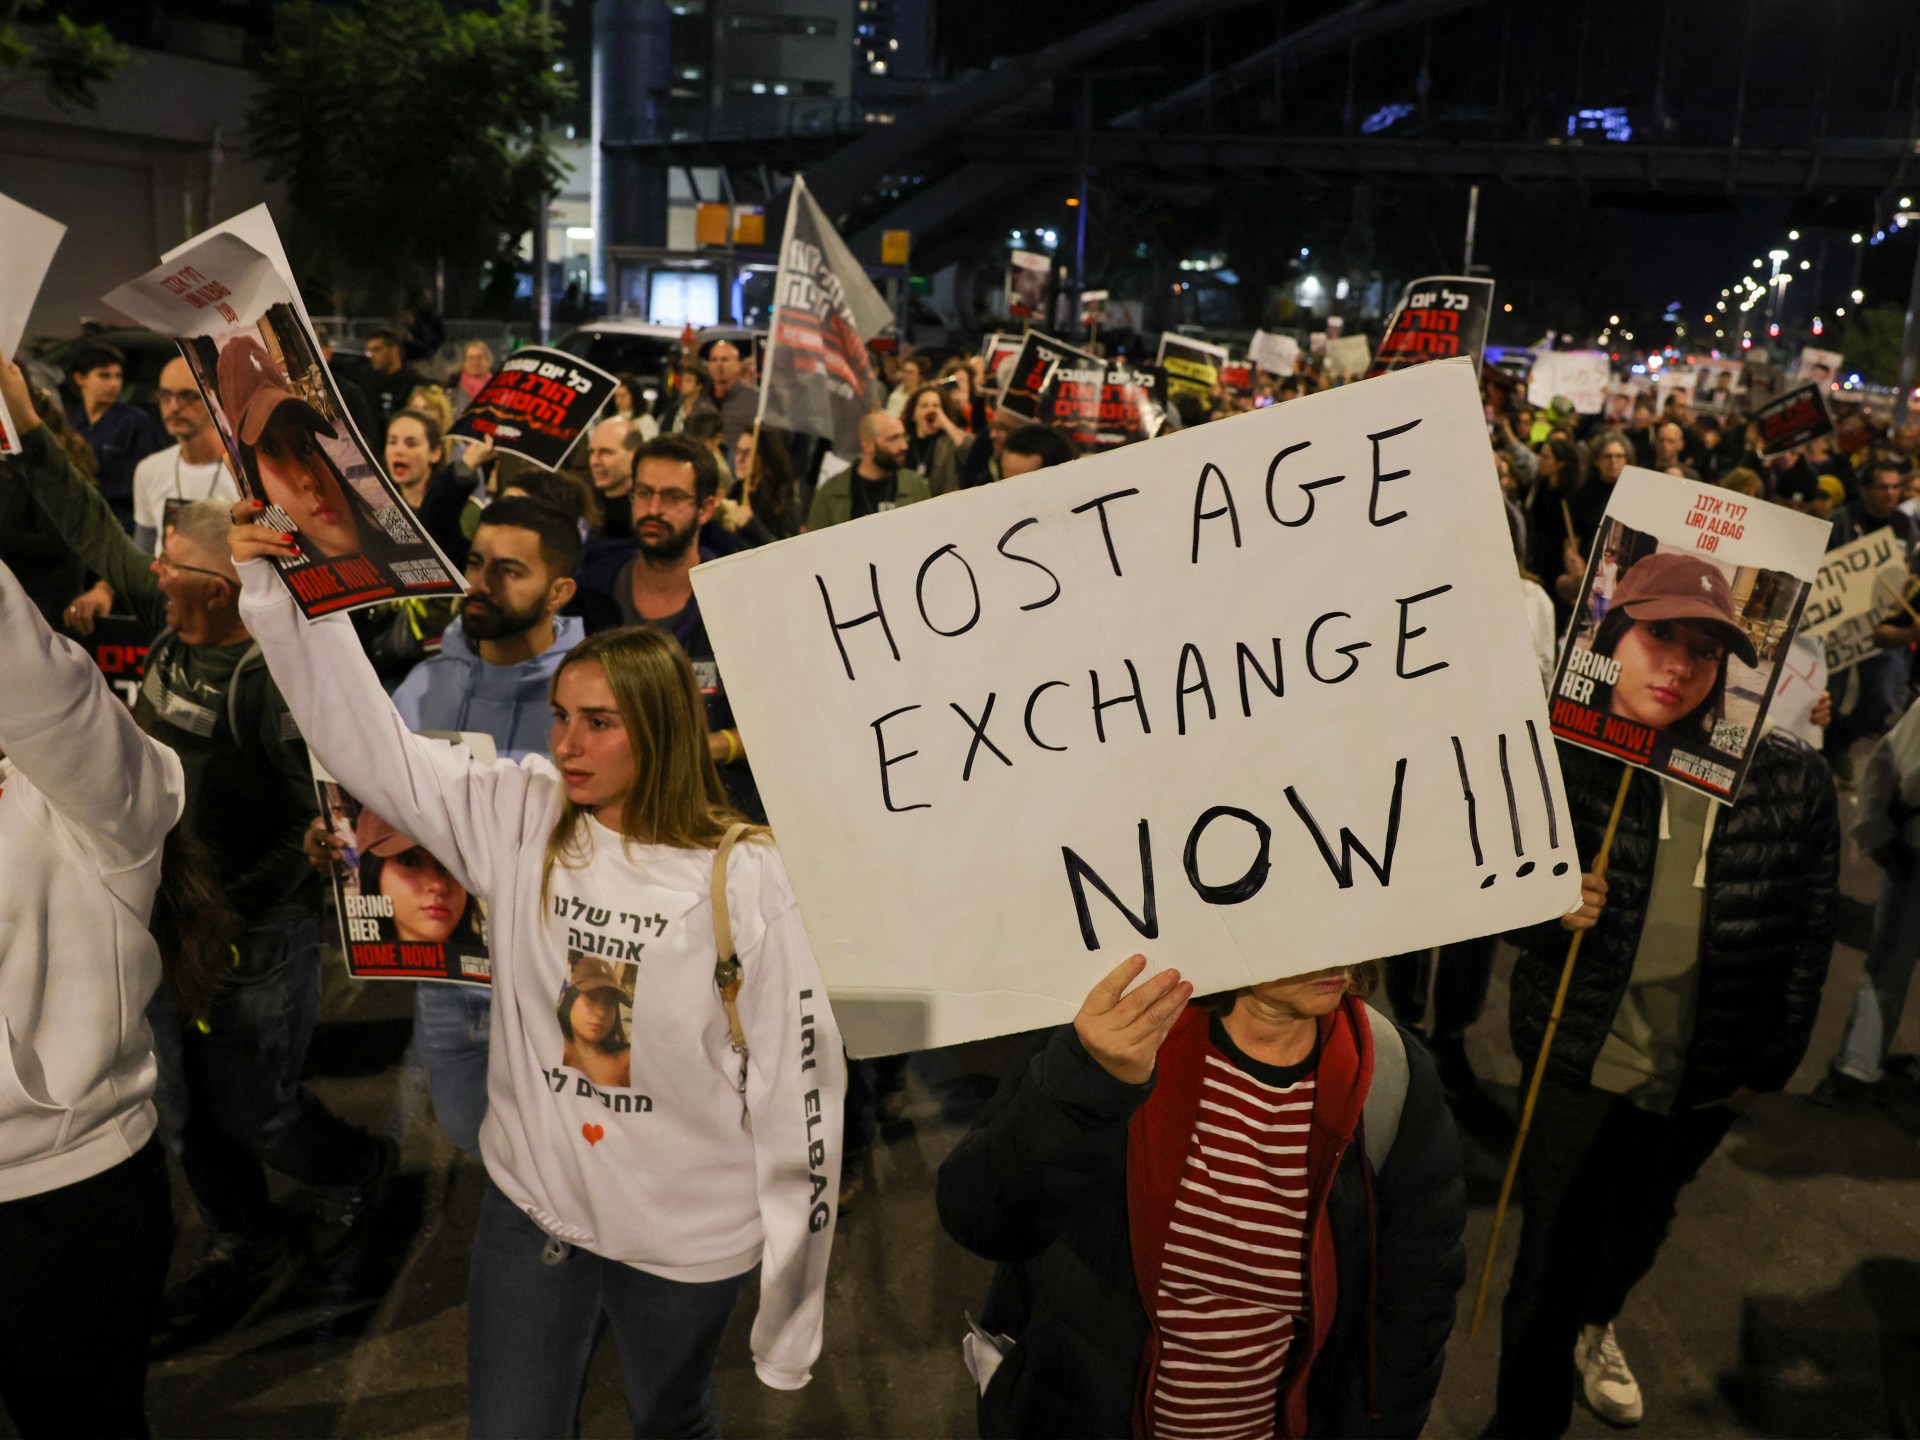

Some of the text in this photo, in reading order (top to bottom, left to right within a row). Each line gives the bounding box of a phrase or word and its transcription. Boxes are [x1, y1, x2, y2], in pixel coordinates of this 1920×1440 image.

[1410, 288, 1470, 311] כל יום
[1398, 309, 1460, 332] הורג
[538, 362, 567, 380] יום
[566, 368, 593, 395] כל
[518, 373, 578, 408] הורג
[1685, 510, 1744, 540] LIRI ALBAG
[1696, 532, 1719, 553] (18)
[815, 418, 1423, 681] HOSTAGE
[288, 564, 345, 602] HOME
[331, 554, 387, 591] NOW!
[1566, 646, 1623, 686] BRING
[869, 584, 1453, 812] EXCHANGE
[1558, 670, 1596, 706] HER
[1552, 698, 1656, 755] HOME NOW!
[343, 894, 395, 918] BRING
[554, 895, 669, 938] לירי שלנו
[348, 918, 382, 942] HER
[568, 926, 646, 963] אהובה
[352, 944, 399, 967] HOME
[400, 943, 447, 969] NOW!
[799, 988, 817, 1073] LIRI
[804, 1088, 831, 1234] ELBAG
